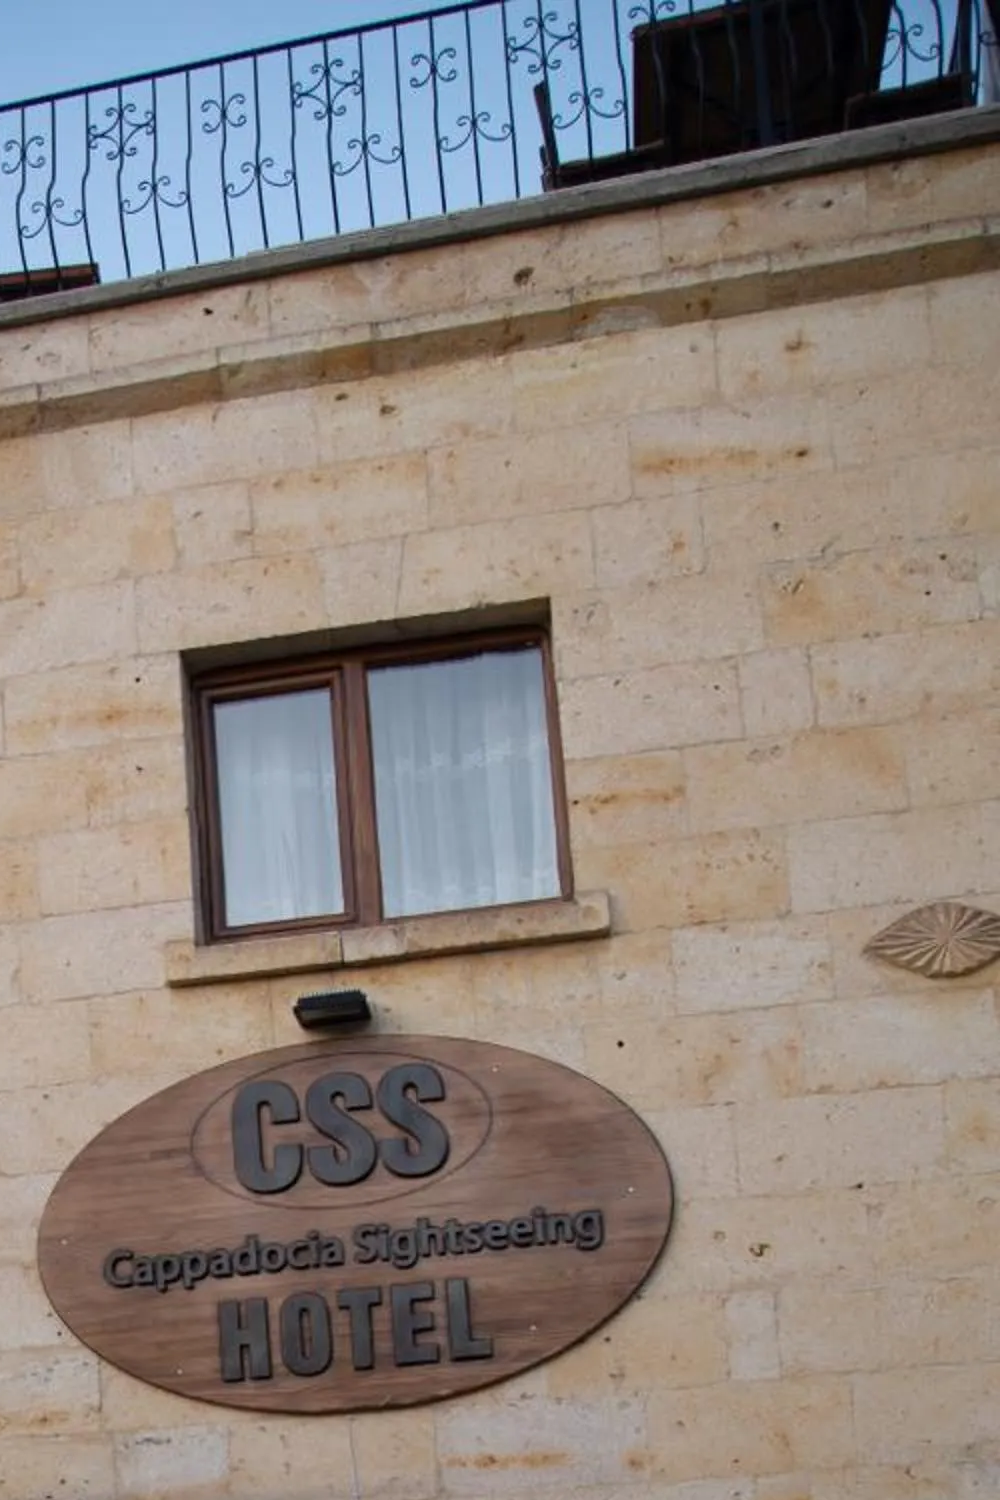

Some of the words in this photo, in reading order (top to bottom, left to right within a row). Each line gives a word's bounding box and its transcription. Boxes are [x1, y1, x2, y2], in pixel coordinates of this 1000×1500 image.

[233, 1063, 450, 1195] CSS
[104, 1230, 345, 1293] Cappadocia
[354, 1206, 605, 1269] Sightseeing
[217, 1278, 495, 1384] HOTEL
